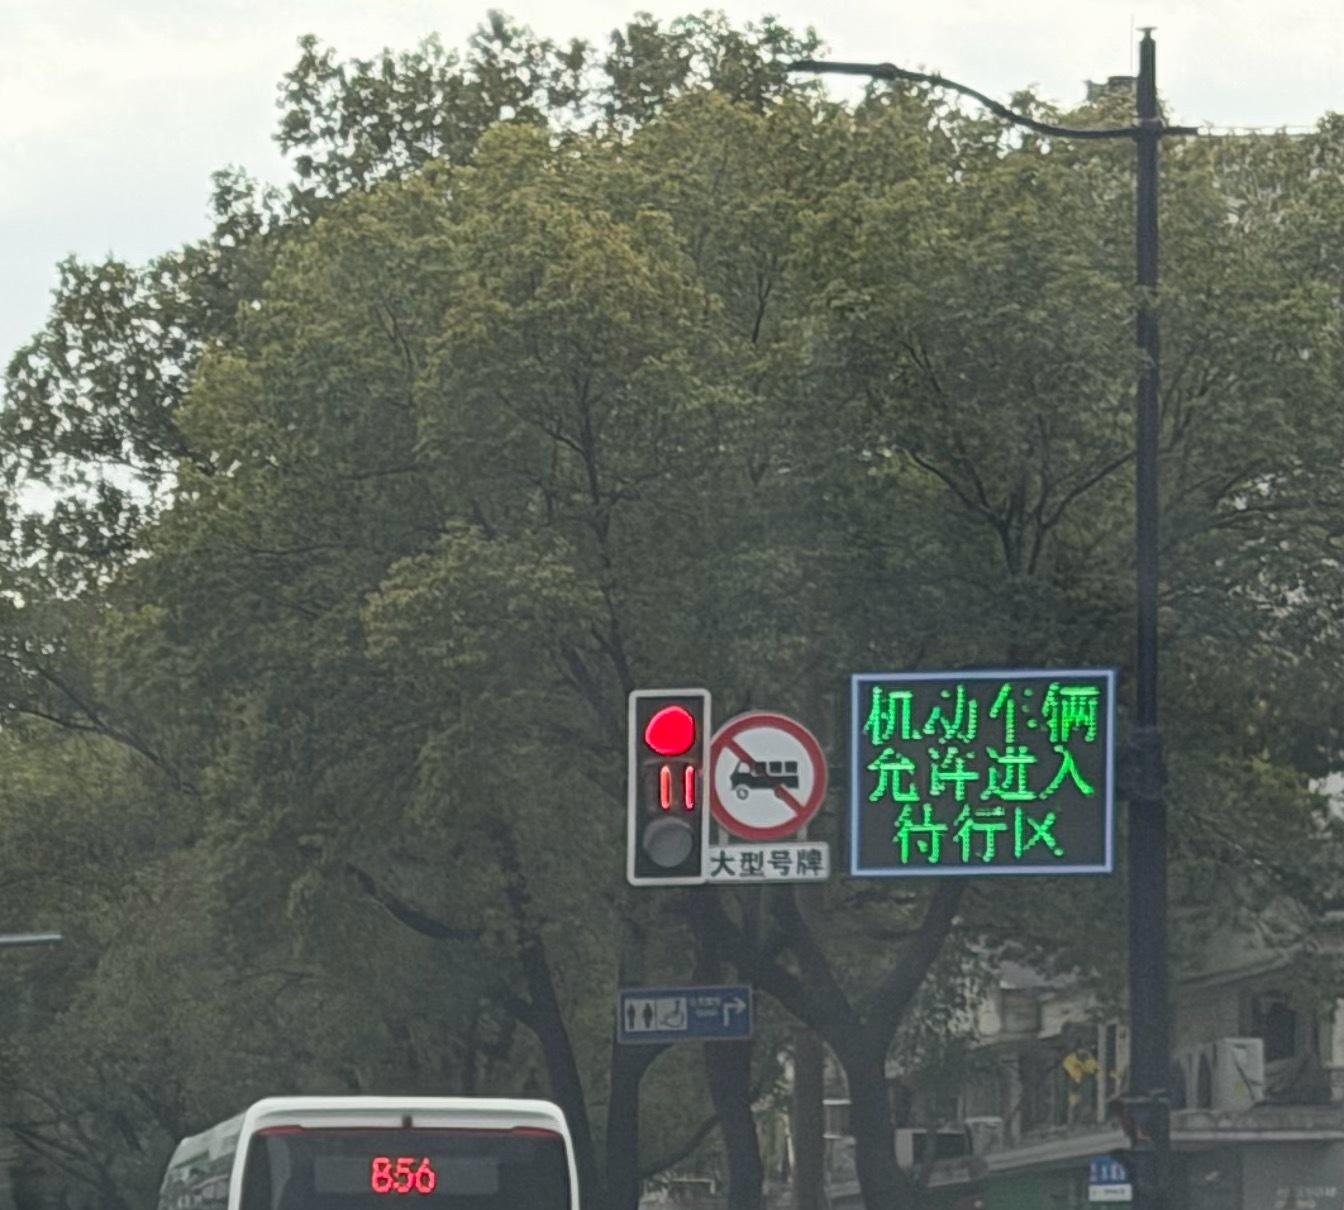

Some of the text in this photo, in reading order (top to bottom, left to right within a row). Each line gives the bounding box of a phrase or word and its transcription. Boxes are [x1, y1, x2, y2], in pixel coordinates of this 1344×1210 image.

[867, 745, 1094, 801] 允许进入
[710, 848, 824, 877] 大型号牌
